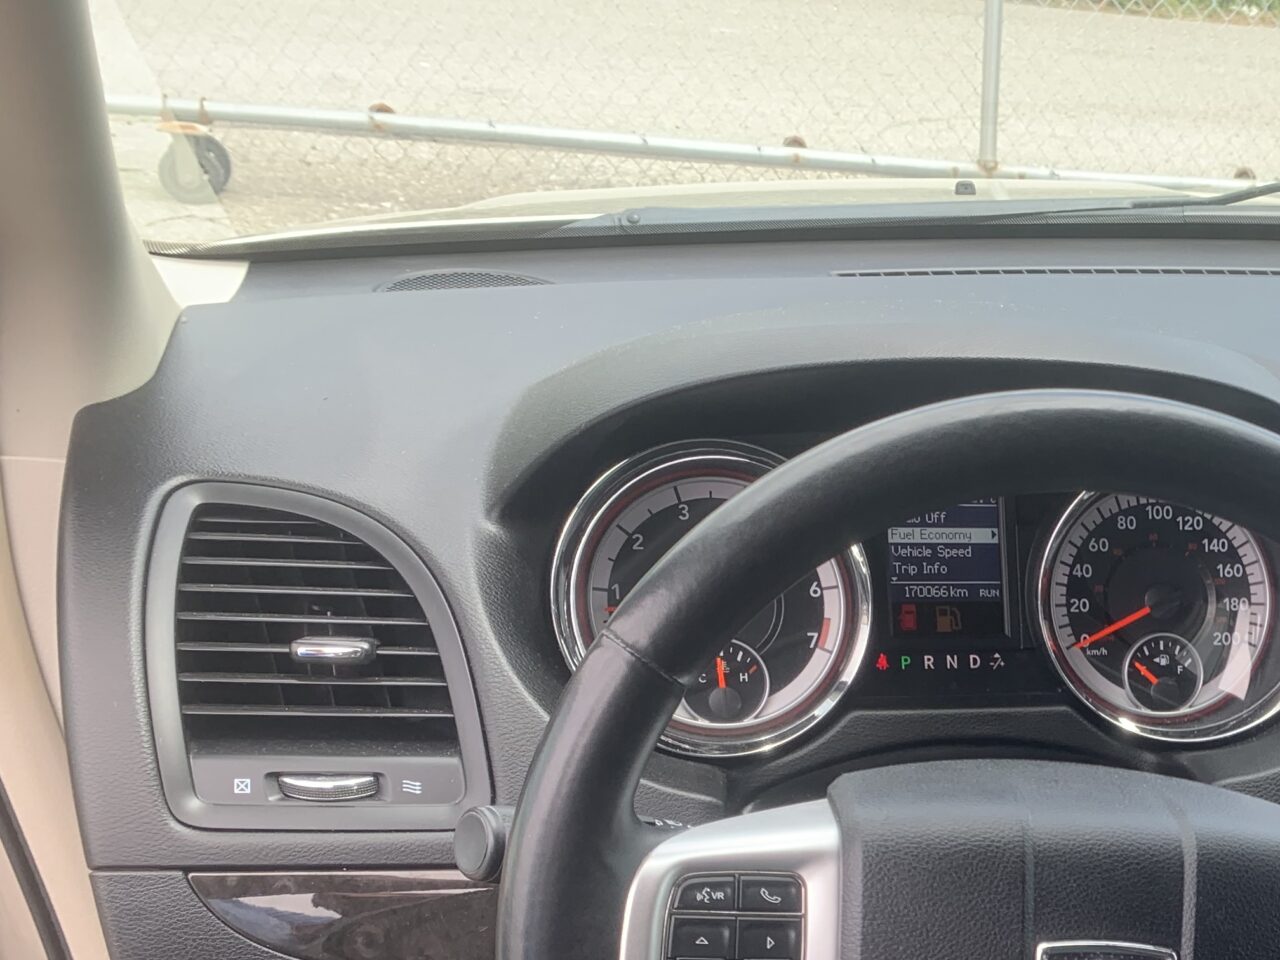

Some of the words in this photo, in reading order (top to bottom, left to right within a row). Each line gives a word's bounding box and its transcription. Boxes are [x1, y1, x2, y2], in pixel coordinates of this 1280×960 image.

[677, 503, 690, 521] 3
[1145, 505, 1173, 520] 100
[1117, 515, 1137, 530] 80
[1176, 516, 1203, 531] 120
[890, 528, 915, 540] Fuel
[920, 528, 972, 542] Economy
[632, 534, 645, 551] 2
[1088, 538, 1109, 552] 60
[1202, 538, 1229, 552] 140
[891, 545, 932, 557] Vehicle
[937, 545, 972, 559] Speed
[893, 562, 918, 576] Trip
[923, 562, 948, 574] Info
[1072, 564, 1092, 578] 40
[1216, 564, 1243, 578] 160
[611, 583, 621, 599] 1
[808, 581, 822, 598] 6
[904, 585, 949, 598] 170066
[950, 586, 968, 598] km
[979, 588, 1000, 598] RUN
[1070, 599, 1090, 612] 20
[1224, 597, 1249, 611] 180
[806, 632, 819, 649] 7
[1212, 632, 1240, 646] 200
[1086, 647, 1108, 656] km/h
[901, 655, 911, 670] P
[924, 655, 935, 670] R
[946, 655, 958, 669] N
[969, 654, 981, 669] D
[739, 672, 749, 683] H
[711, 892, 725, 900] VR
